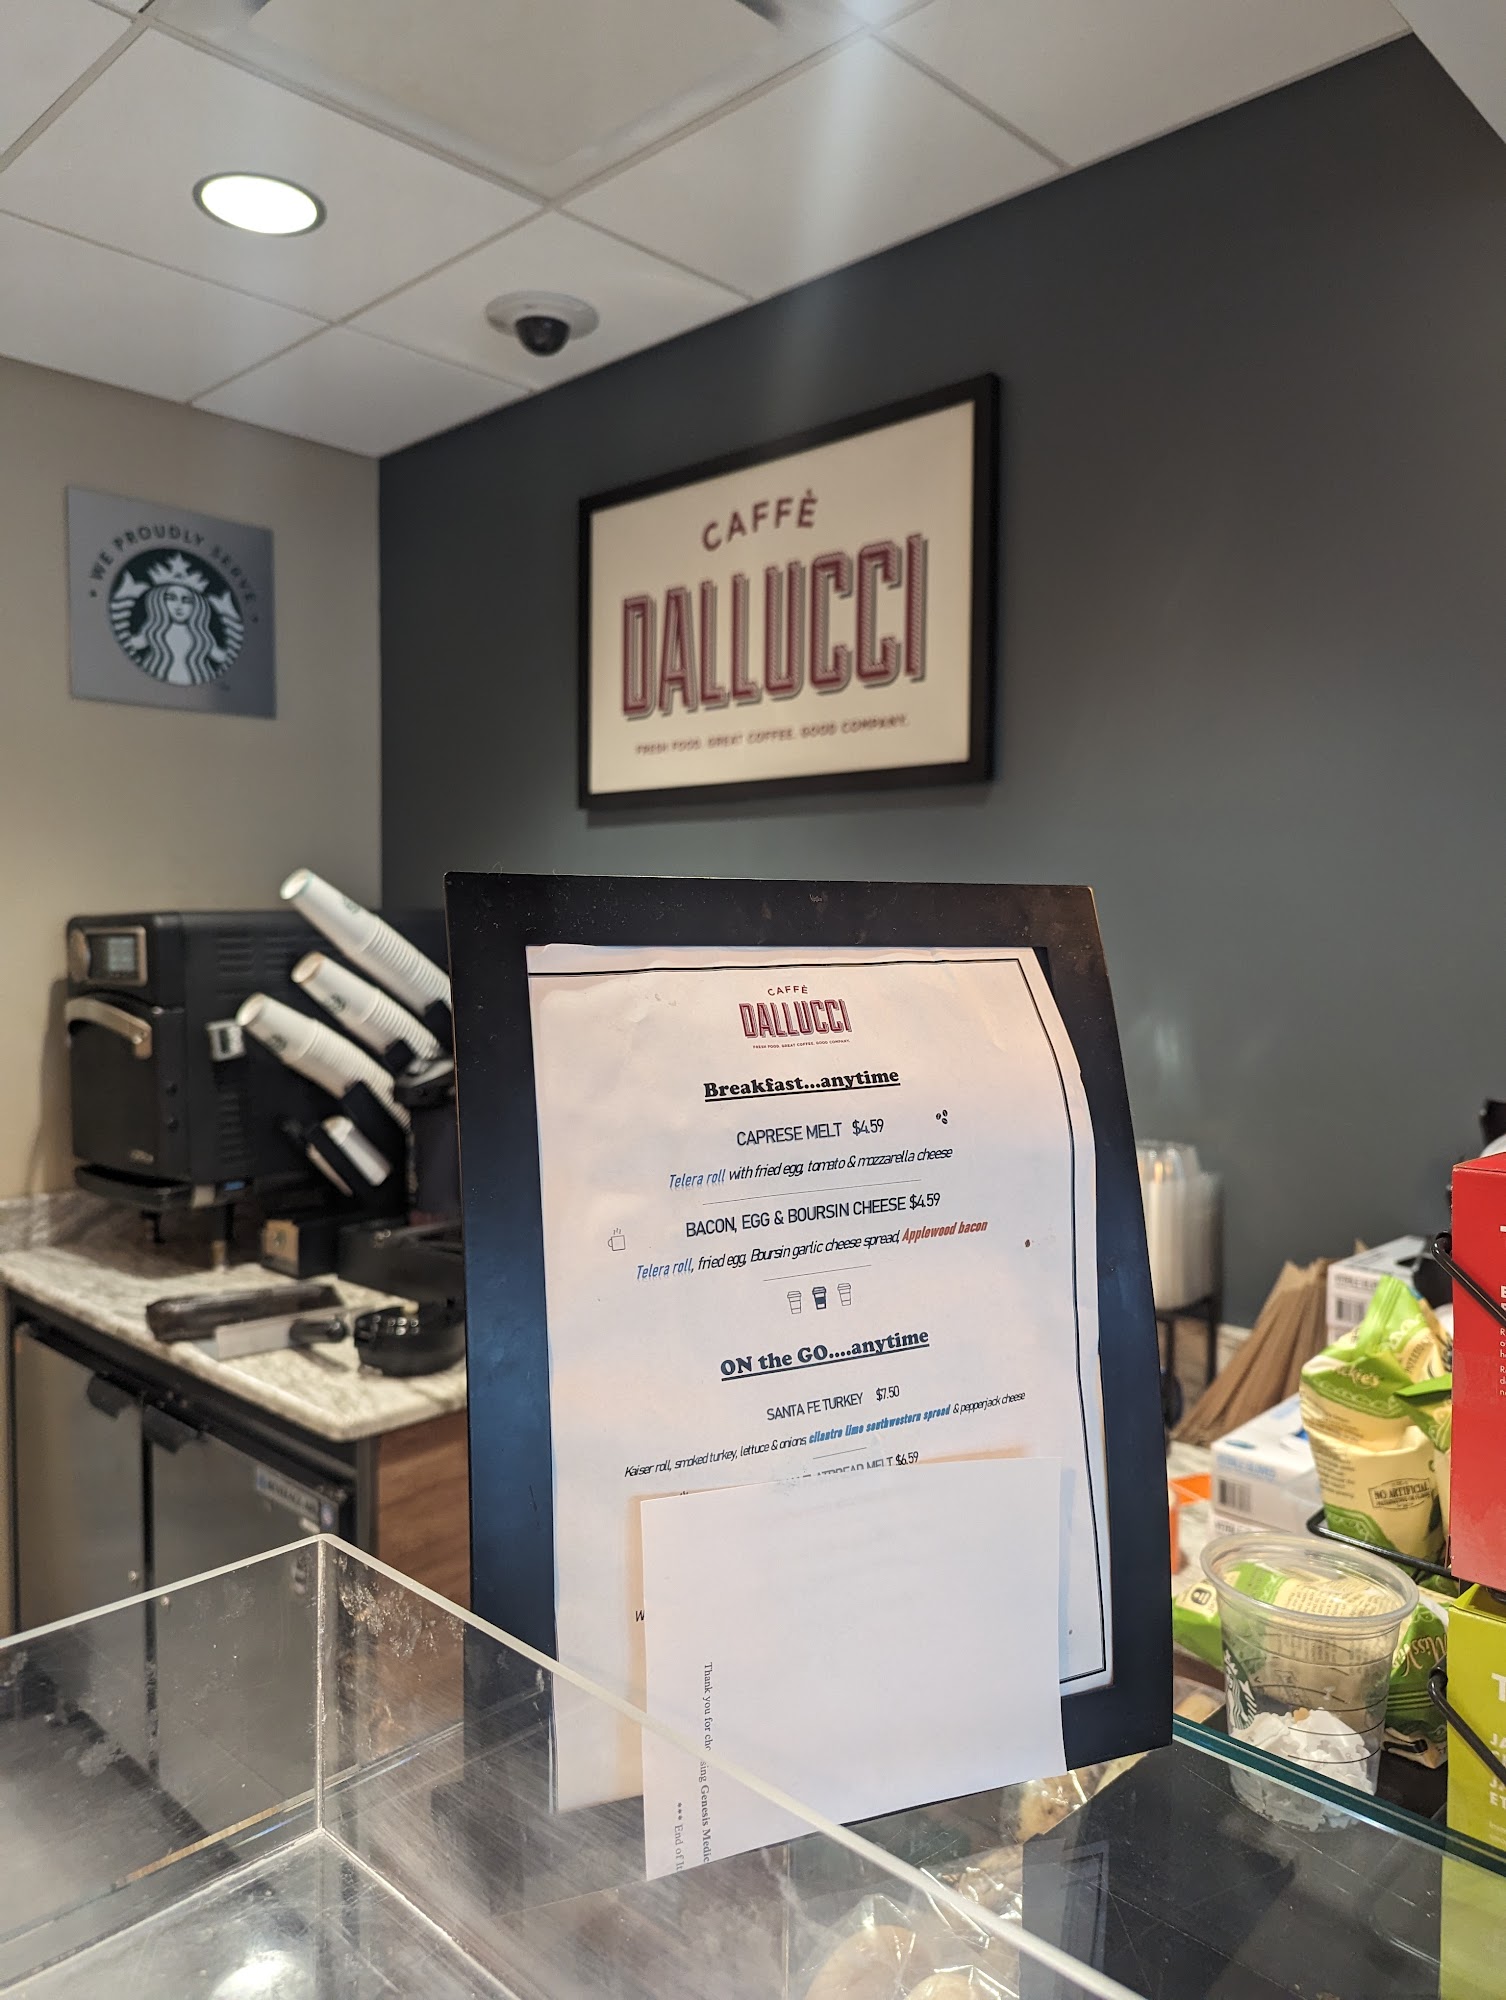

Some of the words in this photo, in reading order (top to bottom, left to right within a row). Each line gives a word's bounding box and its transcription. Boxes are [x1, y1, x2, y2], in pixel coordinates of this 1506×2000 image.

[702, 488, 818, 551] CAFFÈ
[90, 551, 115, 581] WE
[113, 524, 205, 551] PROUDLY
[622, 532, 929, 720] DALLUCCI
[739, 999, 852, 1038] DALLUCCI
[704, 1069, 900, 1099] Breakfast...anytime
[737, 1127, 803, 1146] CAPRESE
[806, 1122, 842, 1141] MELT
[852, 1118, 884, 1136] $4.59
[669, 1174, 703, 1189] Telera
[707, 1169, 725, 1184] roll
[729, 1166, 753, 1181] with
[754, 1163, 781, 1178] fried
[807, 1158, 845, 1172] tomato
[846, 1155, 856, 1168] &
[857, 1149, 915, 1167] mozzarella
[917, 1147, 953, 1161] cheese
[686, 1215, 738, 1237] BACON,
[742, 1212, 770, 1230] EGG
[774, 1210, 784, 1225] &
[788, 1202, 850, 1223] BOURSIN
[853, 1196, 906, 1215] CHEESE
[909, 1192, 940, 1211] $4.59
[637, 1263, 670, 1280] Telera
[673, 1258, 694, 1275] roll,
[697, 1254, 725, 1271] fried
[750, 1245, 790, 1263] Boursin
[792, 1239, 822, 1259] garlic
[825, 1237, 861, 1253] cheese
[902, 1222, 957, 1243] Applewood
[958, 1218, 988, 1235] bacon
[720, 1356, 753, 1377] ON
[757, 1351, 792, 1370] the
[766, 1404, 805, 1421] SANTA
[807, 1400, 821, 1414] FE
[822, 1392, 863, 1412] TURKEY
[875, 1385, 900, 1402] $7.50
[624, 1465, 653, 1477] Kaiser
[655, 1460, 672, 1474] roll,
[674, 1453, 708, 1469] smoked
[709, 1449, 738, 1463] turkey,
[740, 1443, 769, 1457] lettuce
[771, 1439, 779, 1451] &
[808, 1427, 842, 1445] cilantro
[844, 1422, 864, 1437] lime
[866, 1411, 921, 1433] southwestern
[923, 1404, 951, 1421] spread
[952, 1402, 960, 1414] &
[1001, 1391, 1026, 1406] cheese
[895, 1451, 919, 1466] $6.59
[704, 1662, 713, 1694] Thank
[702, 1696, 711, 1715] you
[704, 1716, 713, 1732] for
[700, 1784, 711, 1827] Genesis
[674, 1824, 684, 1846] End
[675, 1848, 684, 1860] of
